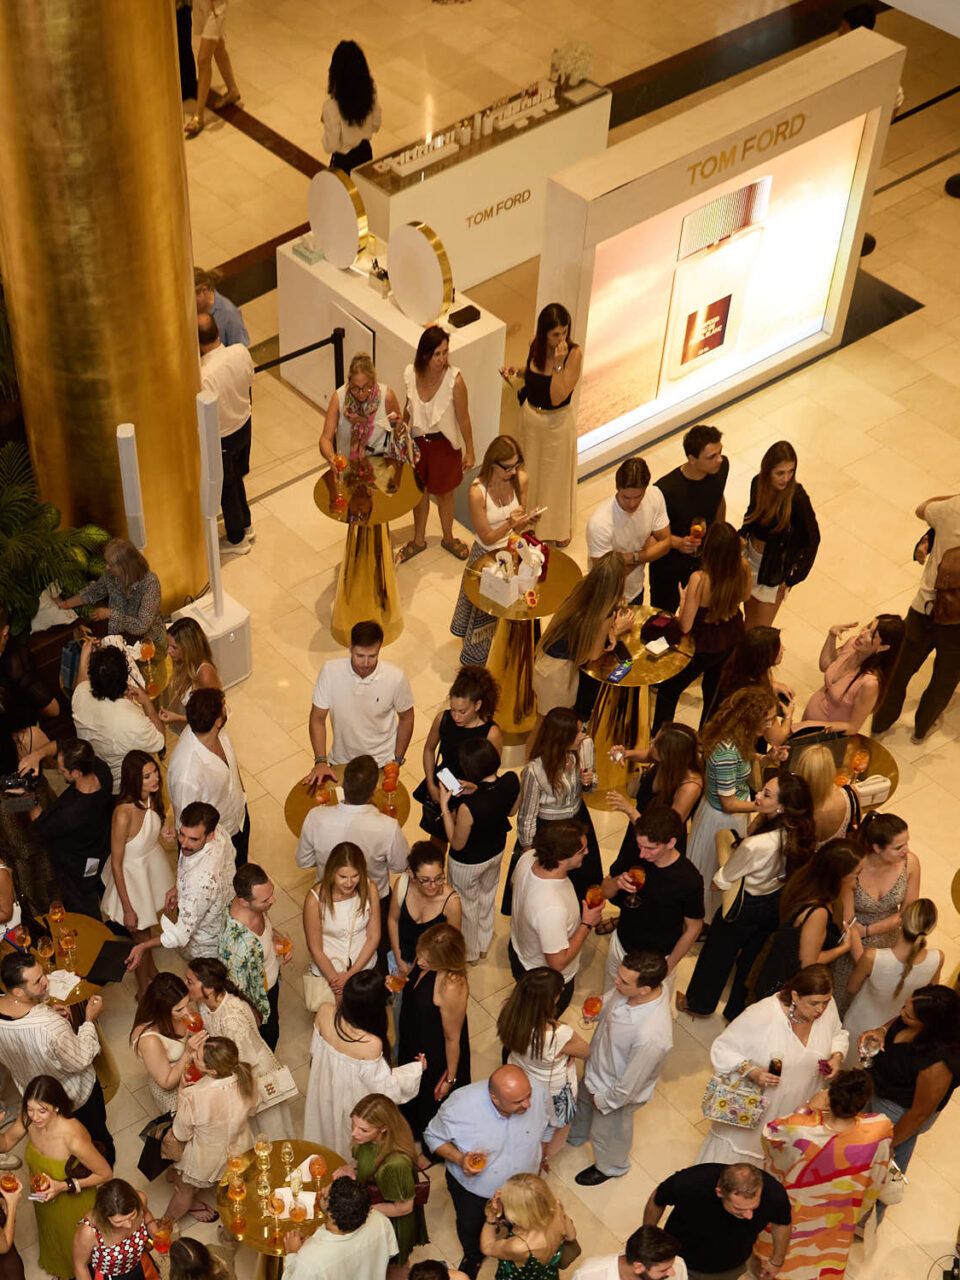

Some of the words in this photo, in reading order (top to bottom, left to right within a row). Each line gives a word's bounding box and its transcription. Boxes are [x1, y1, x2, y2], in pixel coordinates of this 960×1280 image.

[687, 145, 737, 185] TOM
[741, 112, 807, 162] FORD
[465, 202, 495, 229] TOM
[496, 189, 532, 216] FORD
